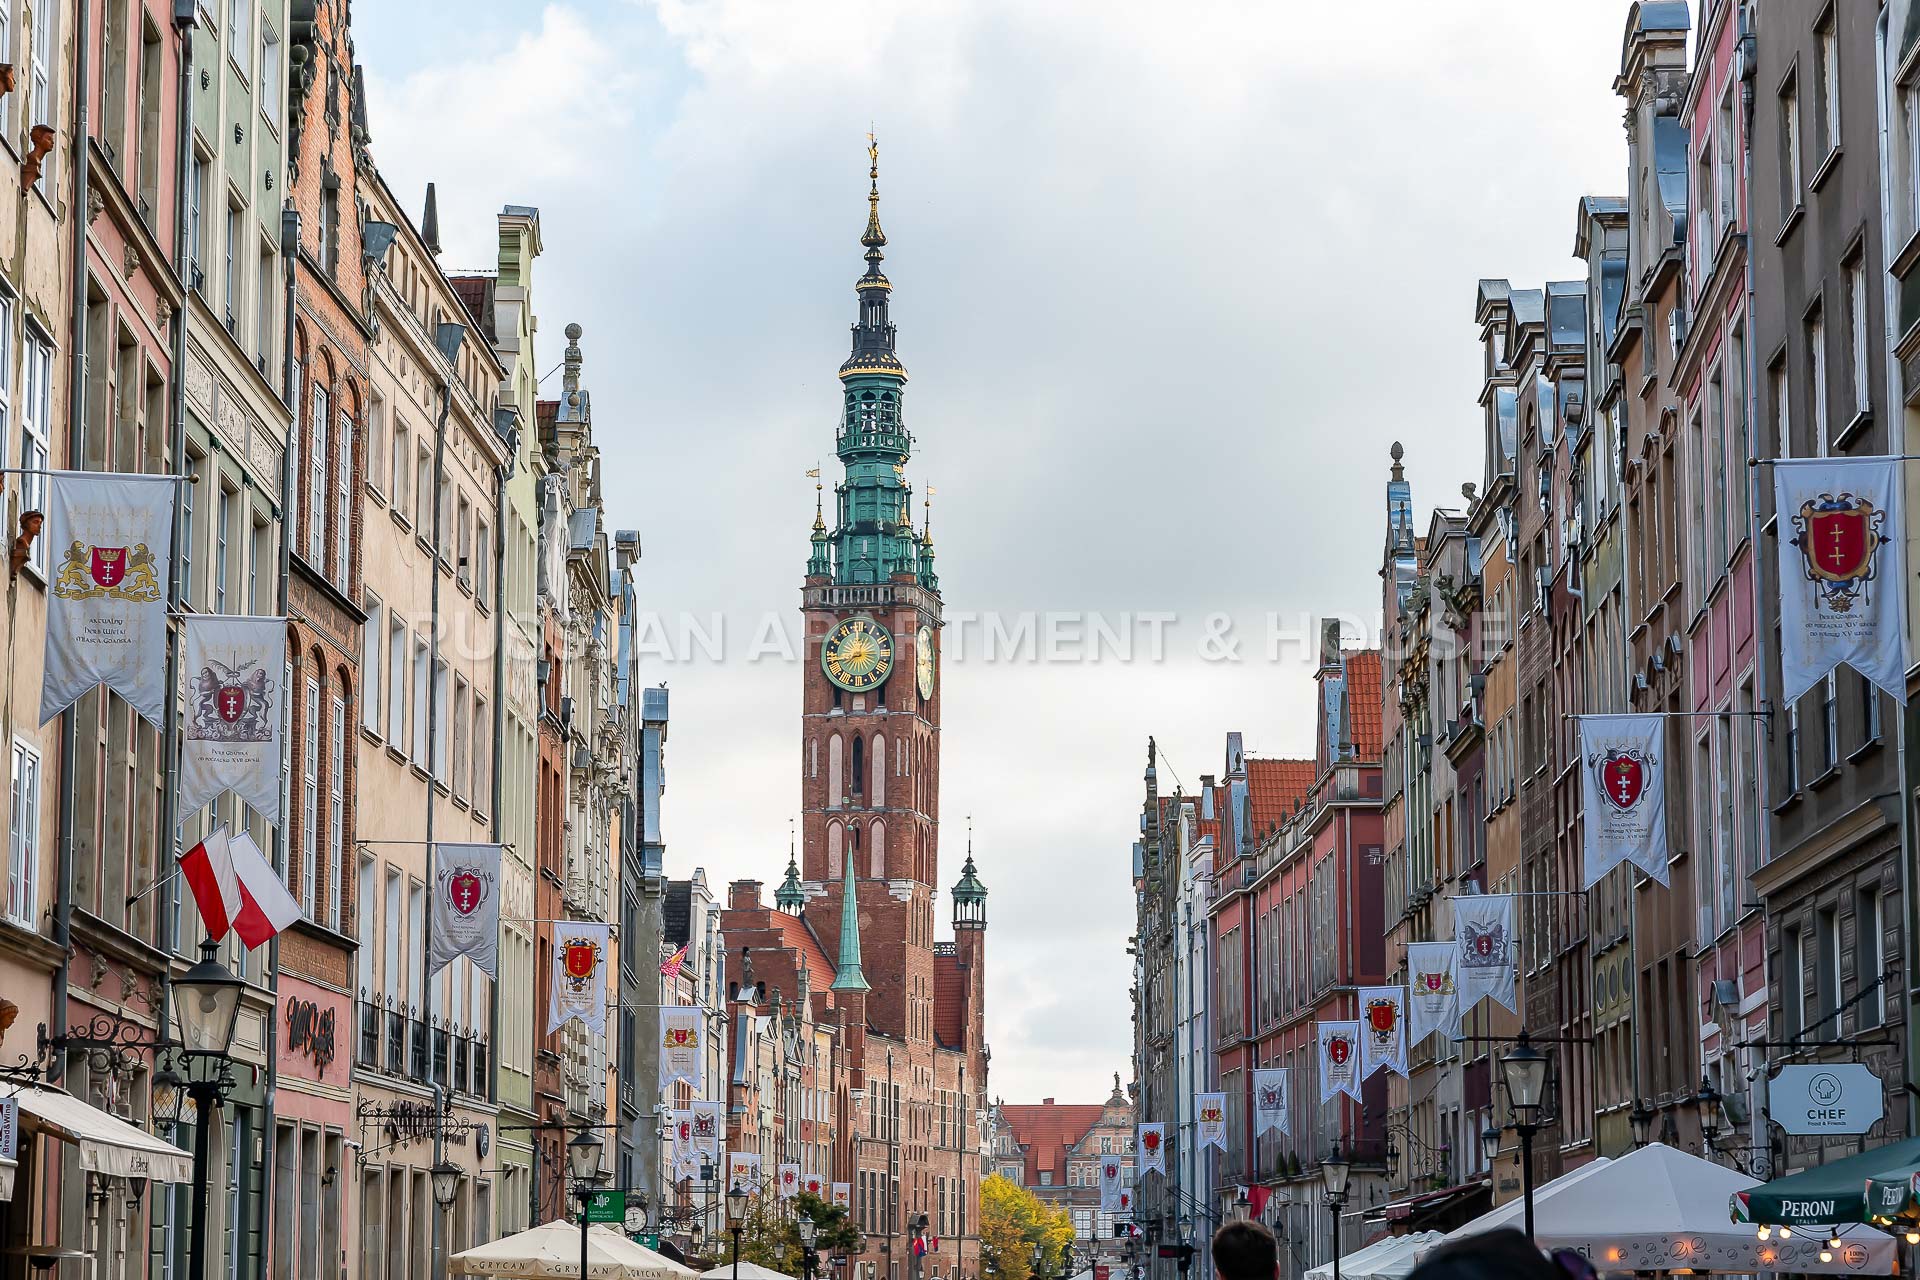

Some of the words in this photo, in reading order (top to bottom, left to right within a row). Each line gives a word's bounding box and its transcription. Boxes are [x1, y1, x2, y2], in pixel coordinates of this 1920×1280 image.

[1807, 1109, 1847, 1120] CHEF
[3, 1103, 12, 1153] Bread&Wine
[1780, 1200, 1836, 1217] PERONI
[479, 1260, 526, 1270] GRYCAN
[554, 1264, 609, 1275] GRYAN
